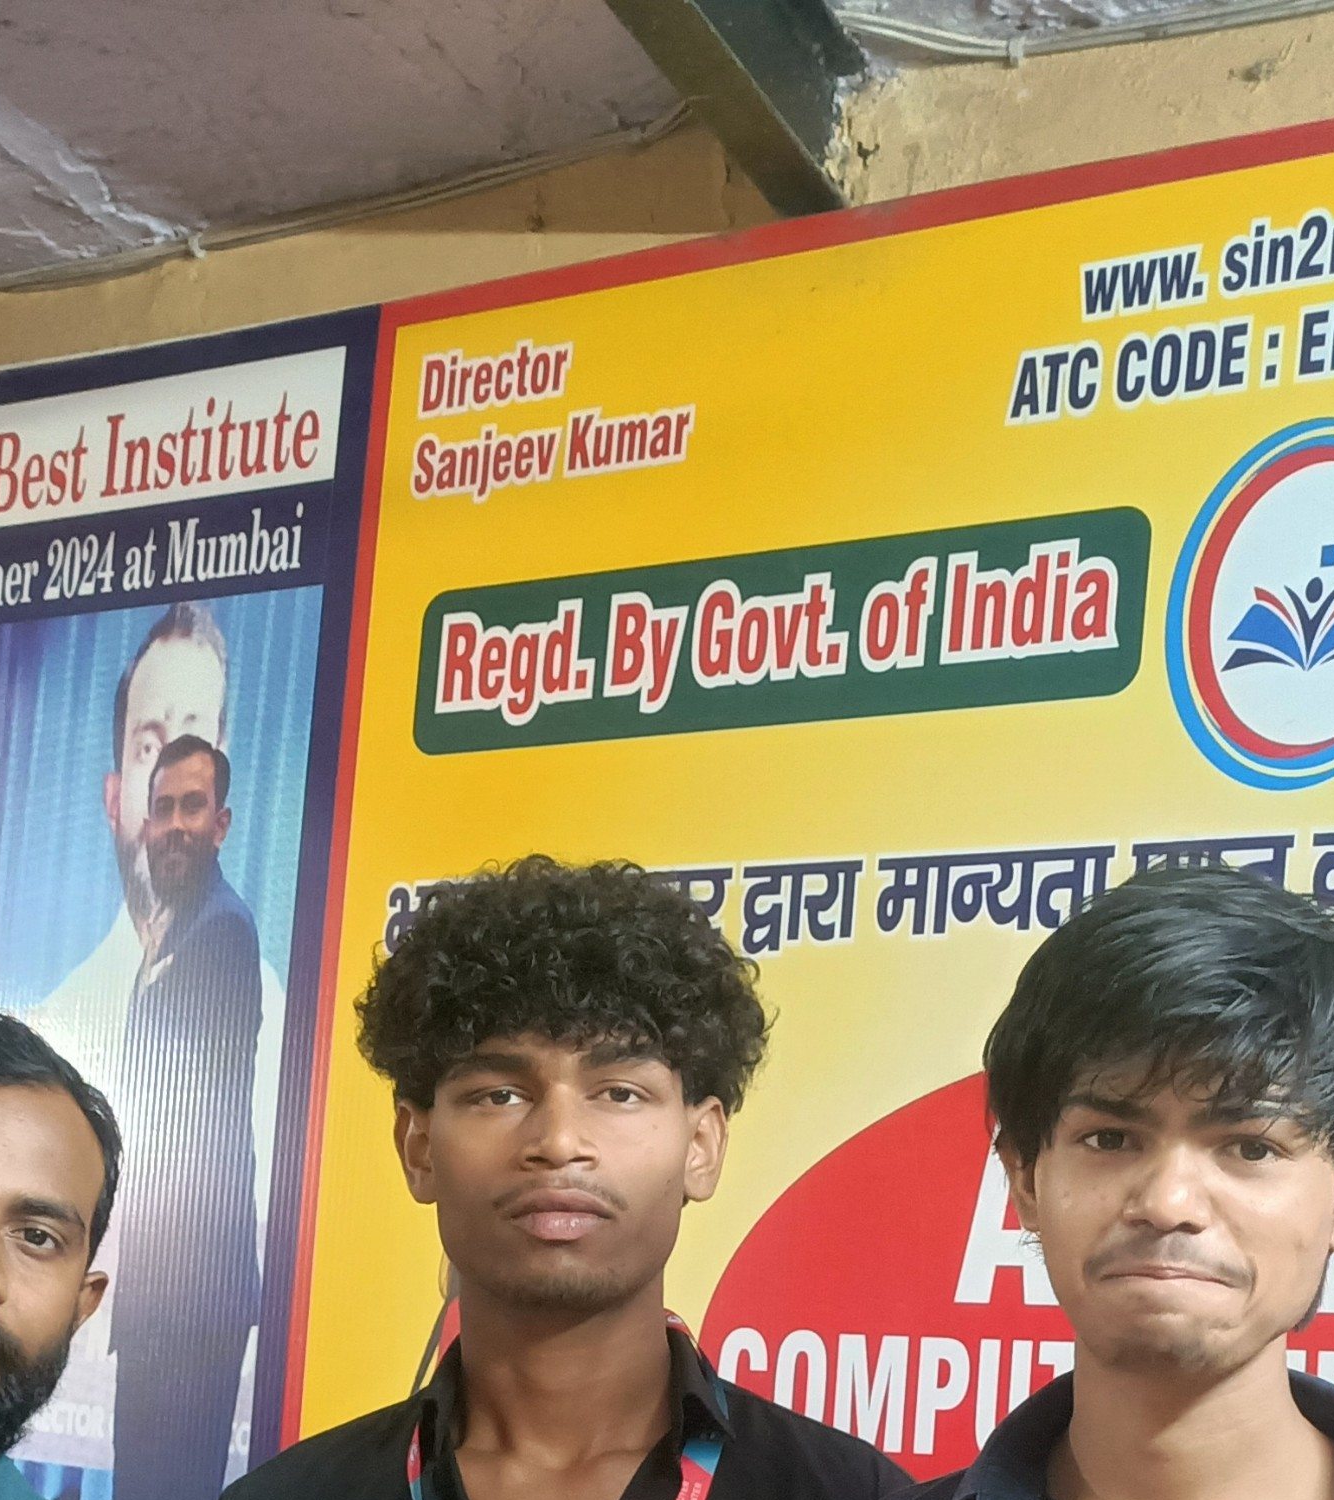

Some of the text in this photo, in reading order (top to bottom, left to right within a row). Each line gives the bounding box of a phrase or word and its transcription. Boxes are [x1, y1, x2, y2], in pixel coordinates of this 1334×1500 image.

[1083, 251, 1203, 314] www.
[422, 343, 570, 411] Director
[1011, 346, 1099, 420] ATC
[1116, 324, 1246, 399] CODE
[100, 391, 320, 498] Institute
[415, 409, 691, 497] Sanjeev Kumar
[44, 534, 115, 602] 2024
[123, 537, 157, 589] at
[163, 501, 305, 586] Mumbai
[440, 549, 1112, 716] Regd. By Govt. of India
[742, 860, 860, 952] द्वारा
[878, 845, 1115, 938] मान्यता
[719, 1330, 1075, 1458] COMPUT
